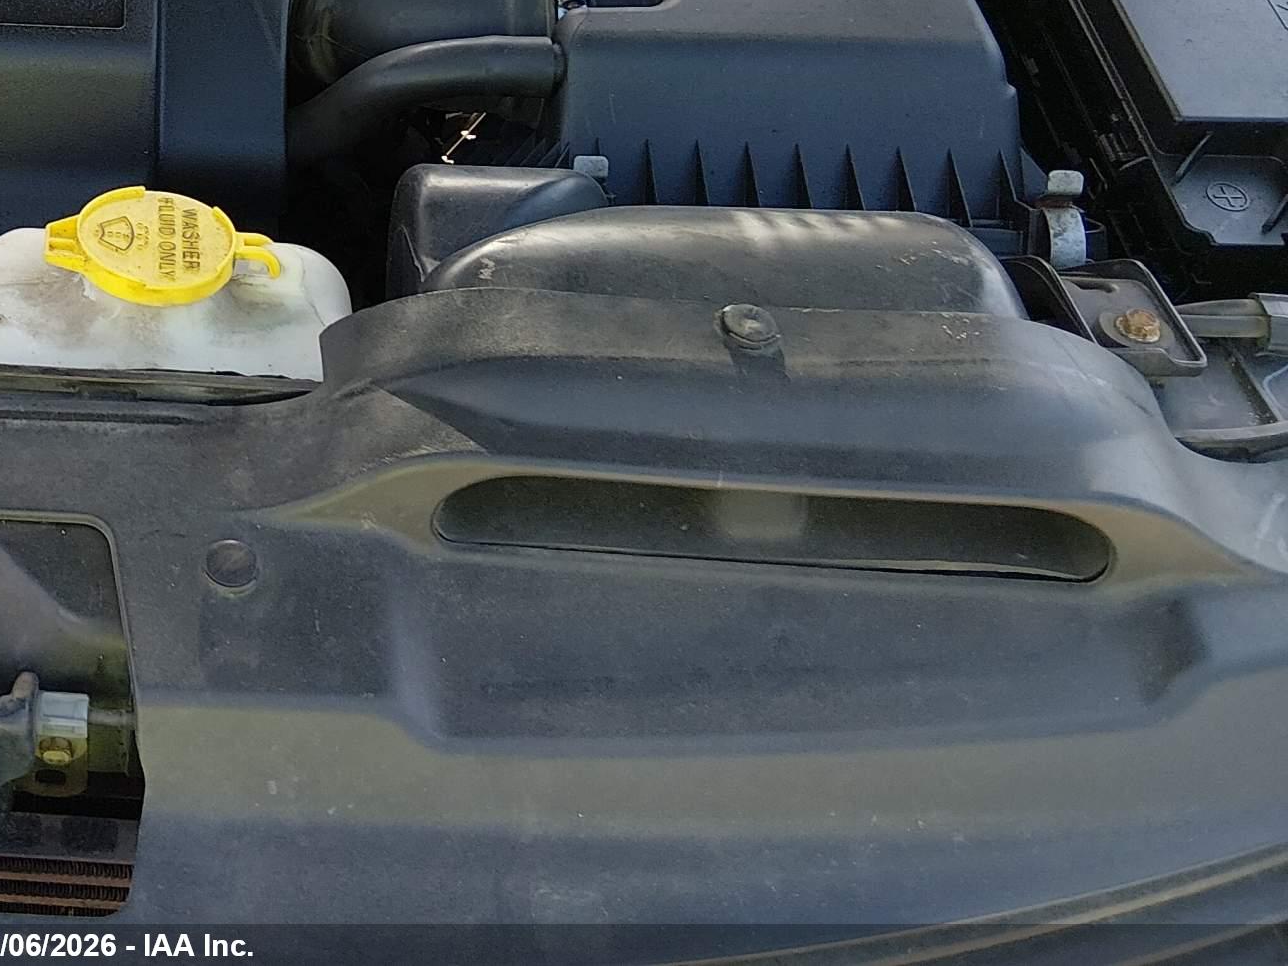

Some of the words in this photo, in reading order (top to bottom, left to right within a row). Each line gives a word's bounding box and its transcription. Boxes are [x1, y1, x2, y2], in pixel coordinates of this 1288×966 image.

[158, 197, 176, 238] FLUID
[158, 240, 176, 282] ONLY
[182, 208, 200, 272] WASHER
